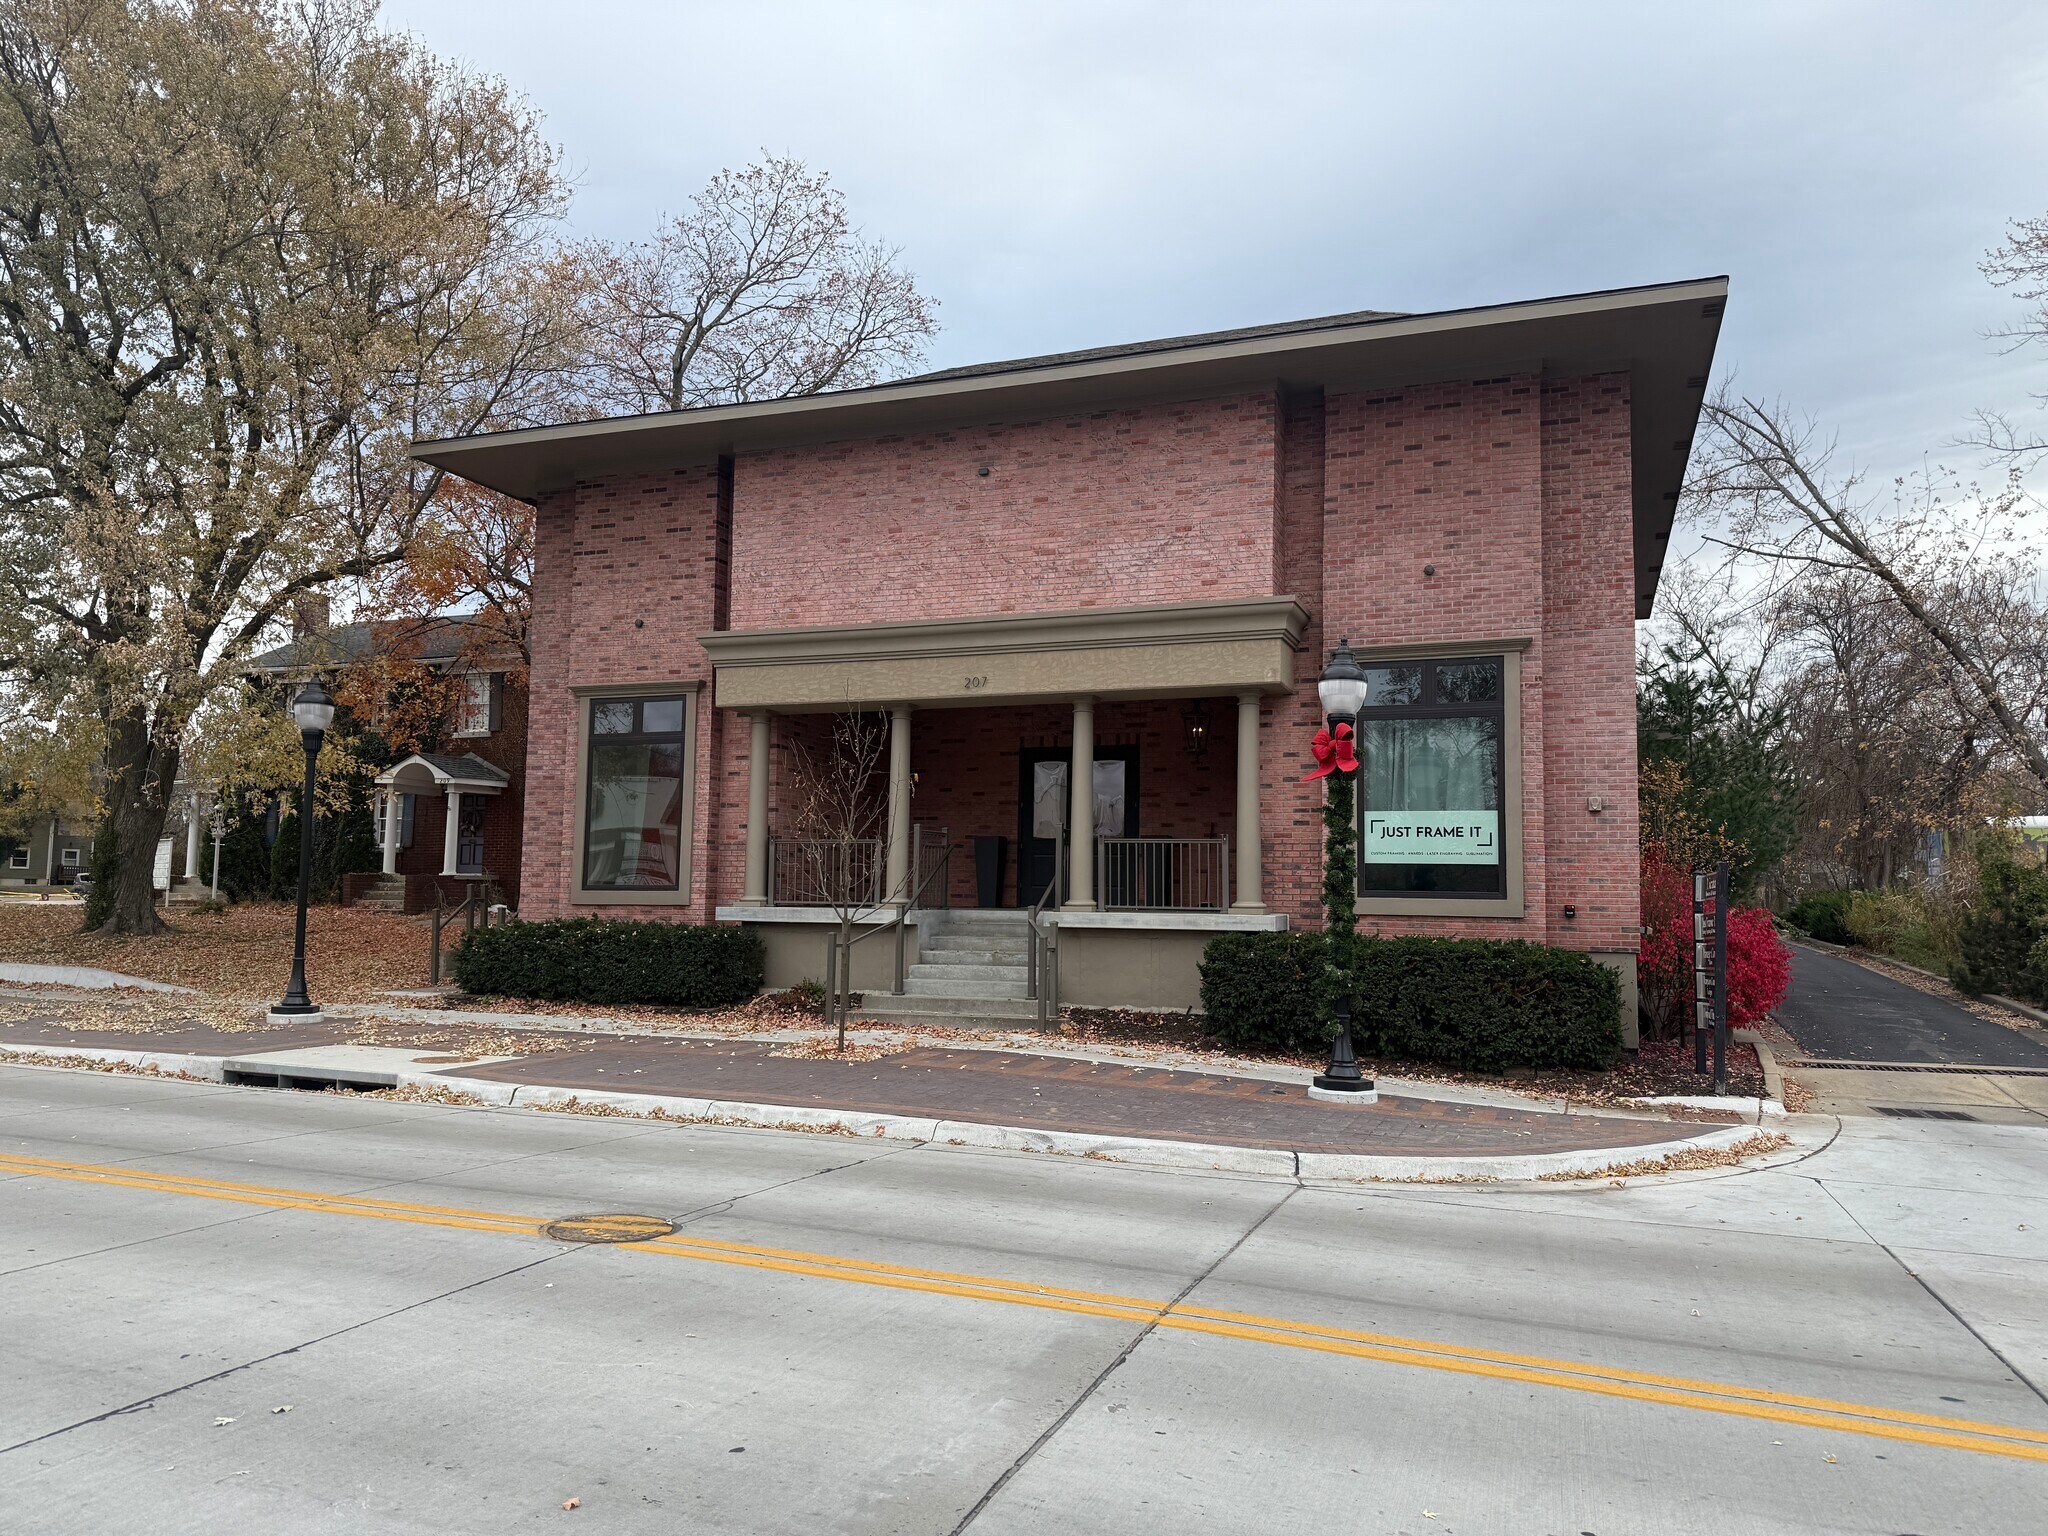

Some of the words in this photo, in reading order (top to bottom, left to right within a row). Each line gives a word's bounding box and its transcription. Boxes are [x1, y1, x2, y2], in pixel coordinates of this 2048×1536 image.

[964, 676, 988, 689] 207
[1381, 826, 1412, 839] JUST
[1416, 826, 1464, 838] FRAME
[1470, 826, 1482, 838] IT
